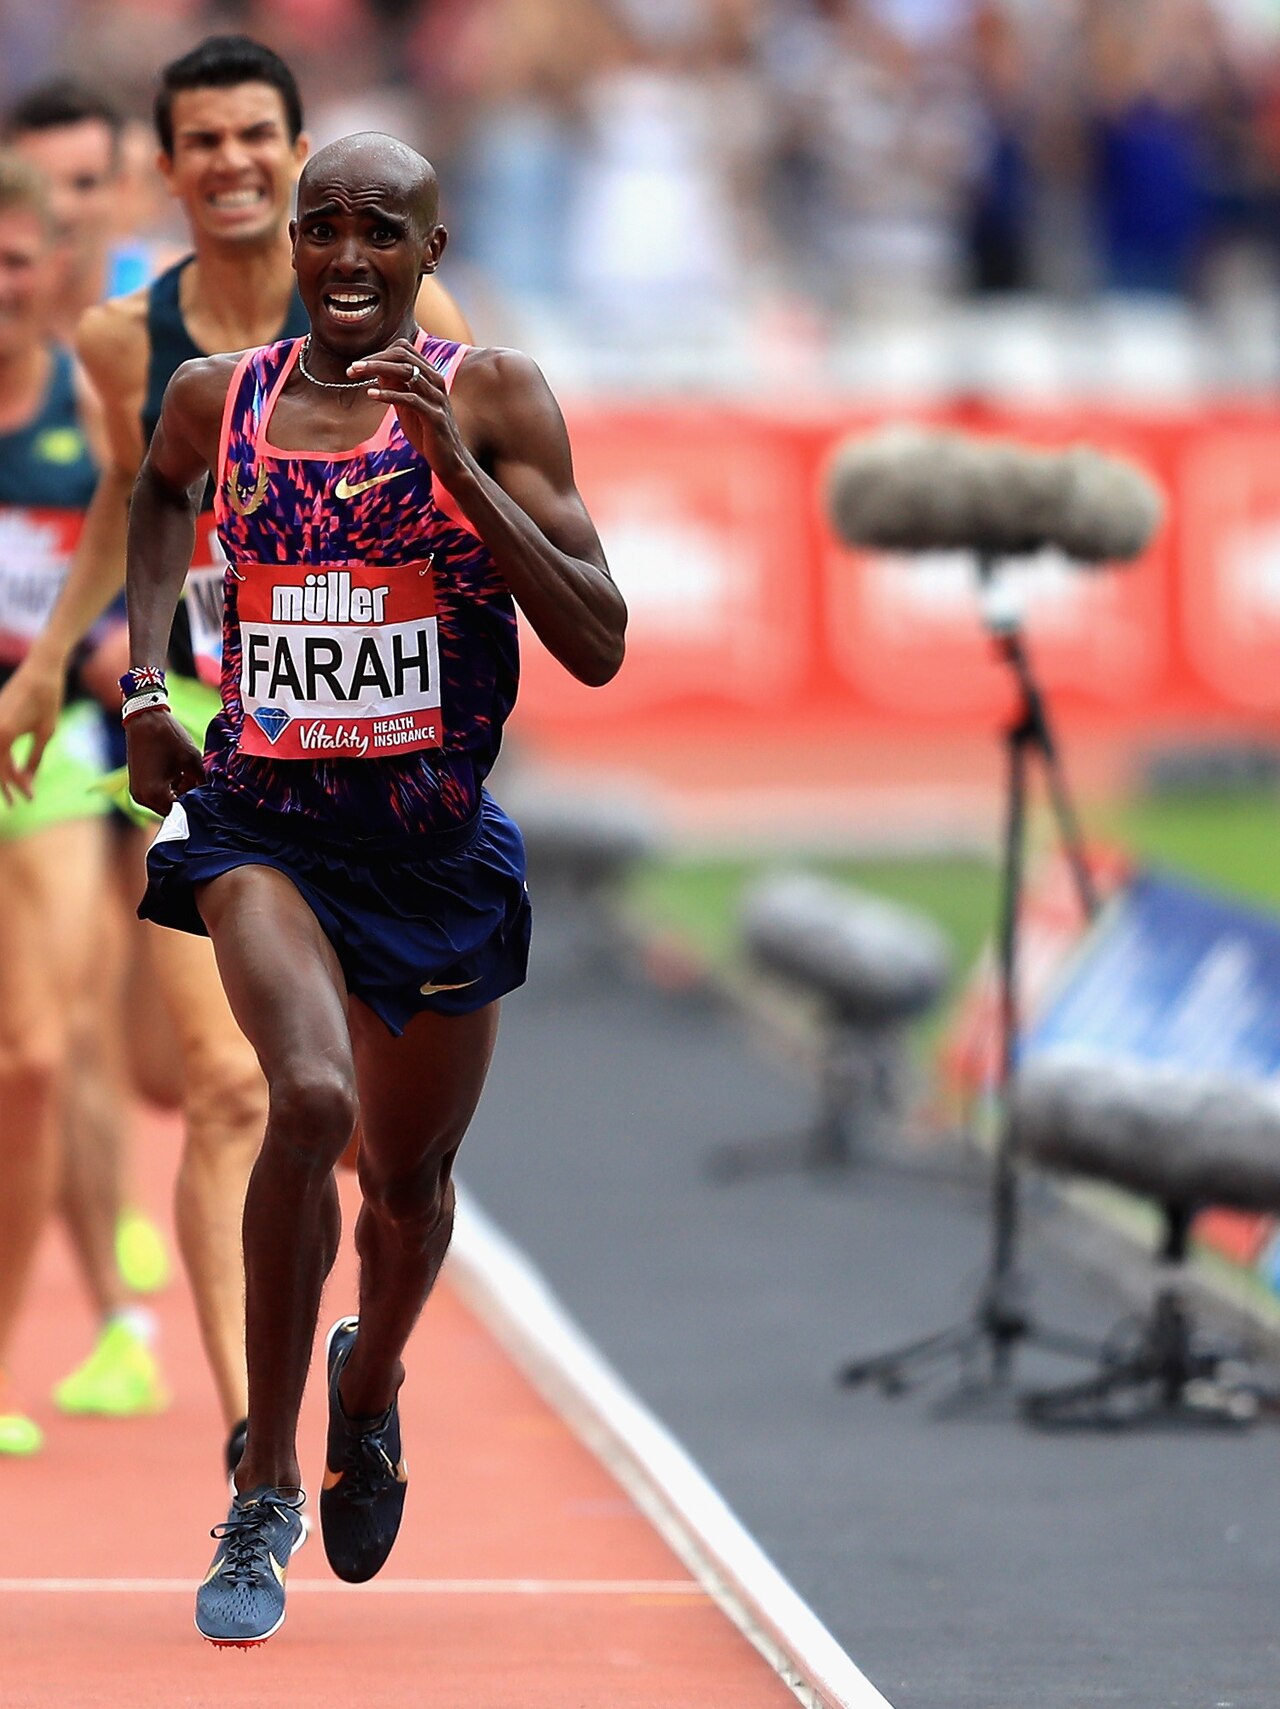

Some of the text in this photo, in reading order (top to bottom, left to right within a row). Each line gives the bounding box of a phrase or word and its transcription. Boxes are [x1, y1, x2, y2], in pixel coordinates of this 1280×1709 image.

[271, 571, 389, 623] müller
[247, 629, 430, 701] FARAH
[299, 719, 371, 758] Vitality
[373, 716, 415, 734] HEALTH
[373, 726, 436, 748] INSURANCE
